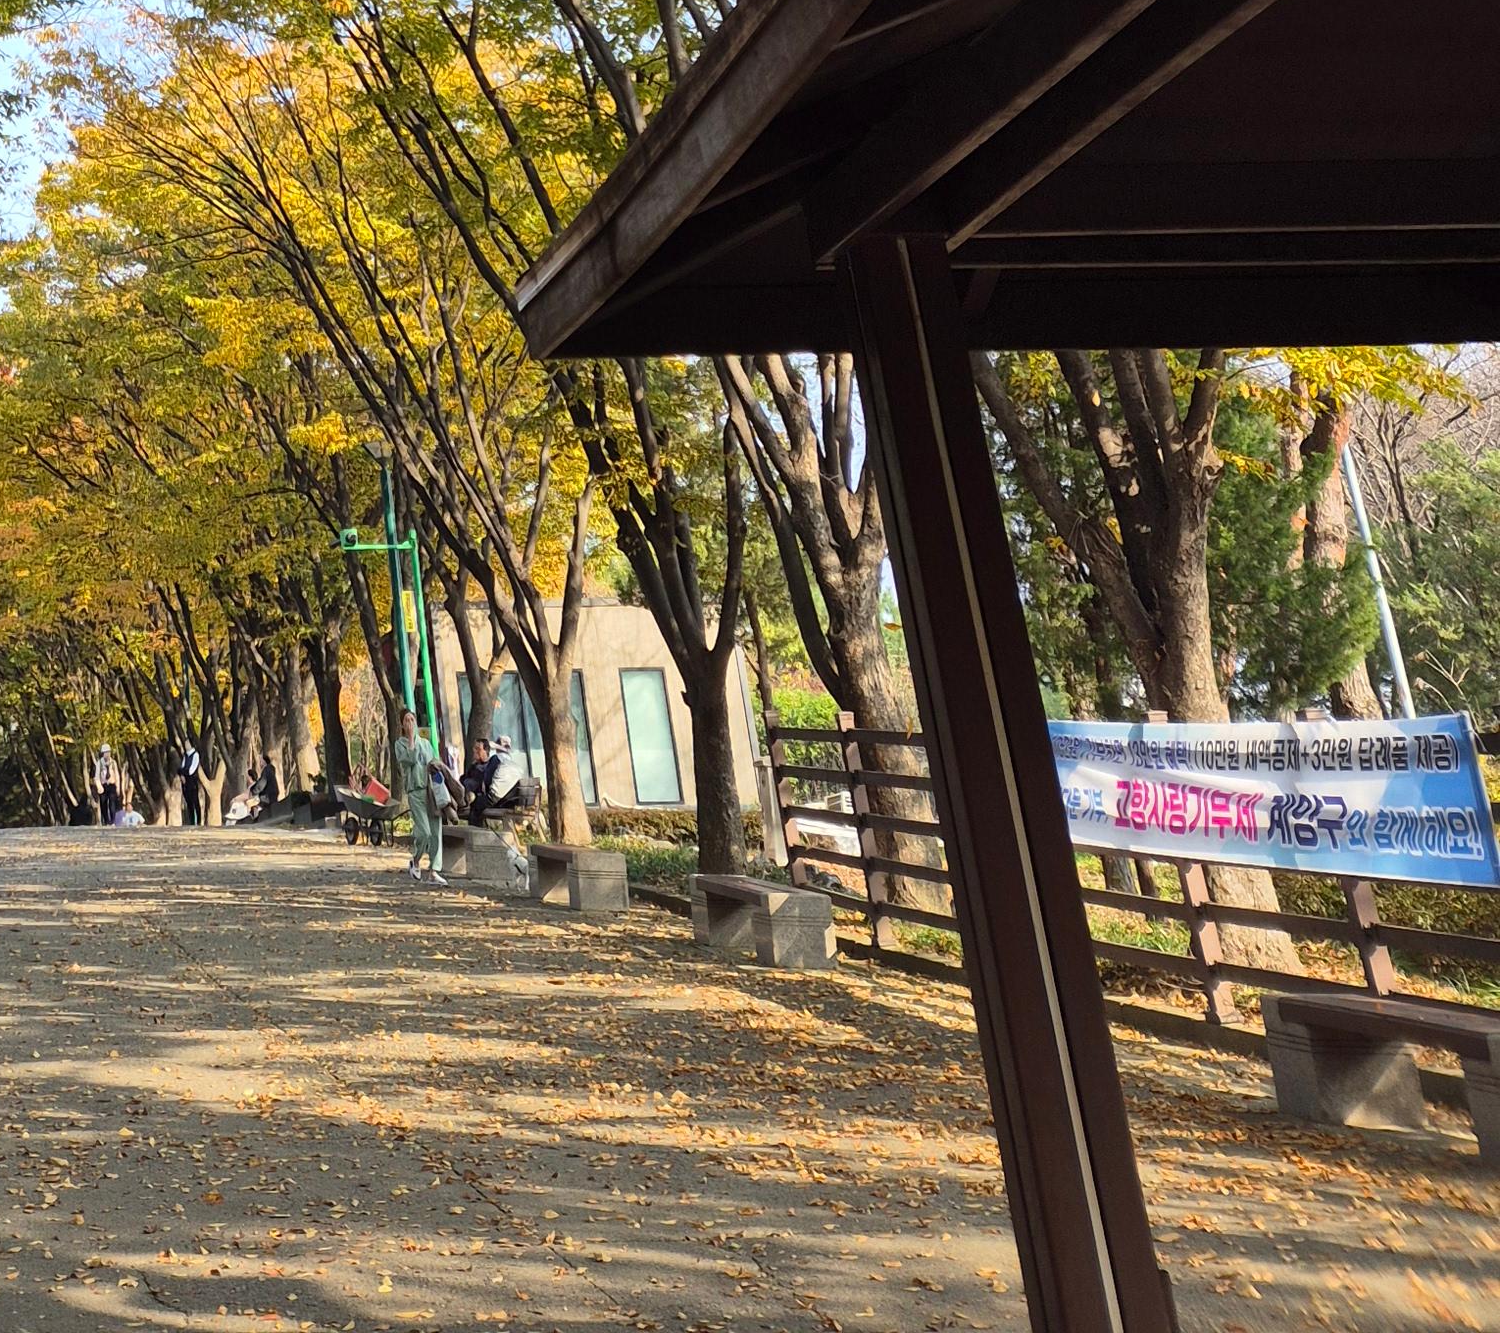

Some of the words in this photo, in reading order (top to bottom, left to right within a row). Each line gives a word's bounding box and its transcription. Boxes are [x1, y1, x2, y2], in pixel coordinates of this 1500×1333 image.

[1127, 740, 1165, 769] 13만원
[1166, 740, 1192, 771] 혜택!
[1194, 739, 1240, 771] (10만원
[1245, 737, 1352, 771] 세액공제+3만원
[1358, 736, 1408, 771] 답례품
[1414, 734, 1459, 771] 제공)
[1115, 779, 1264, 842] 고향사랑기부제
